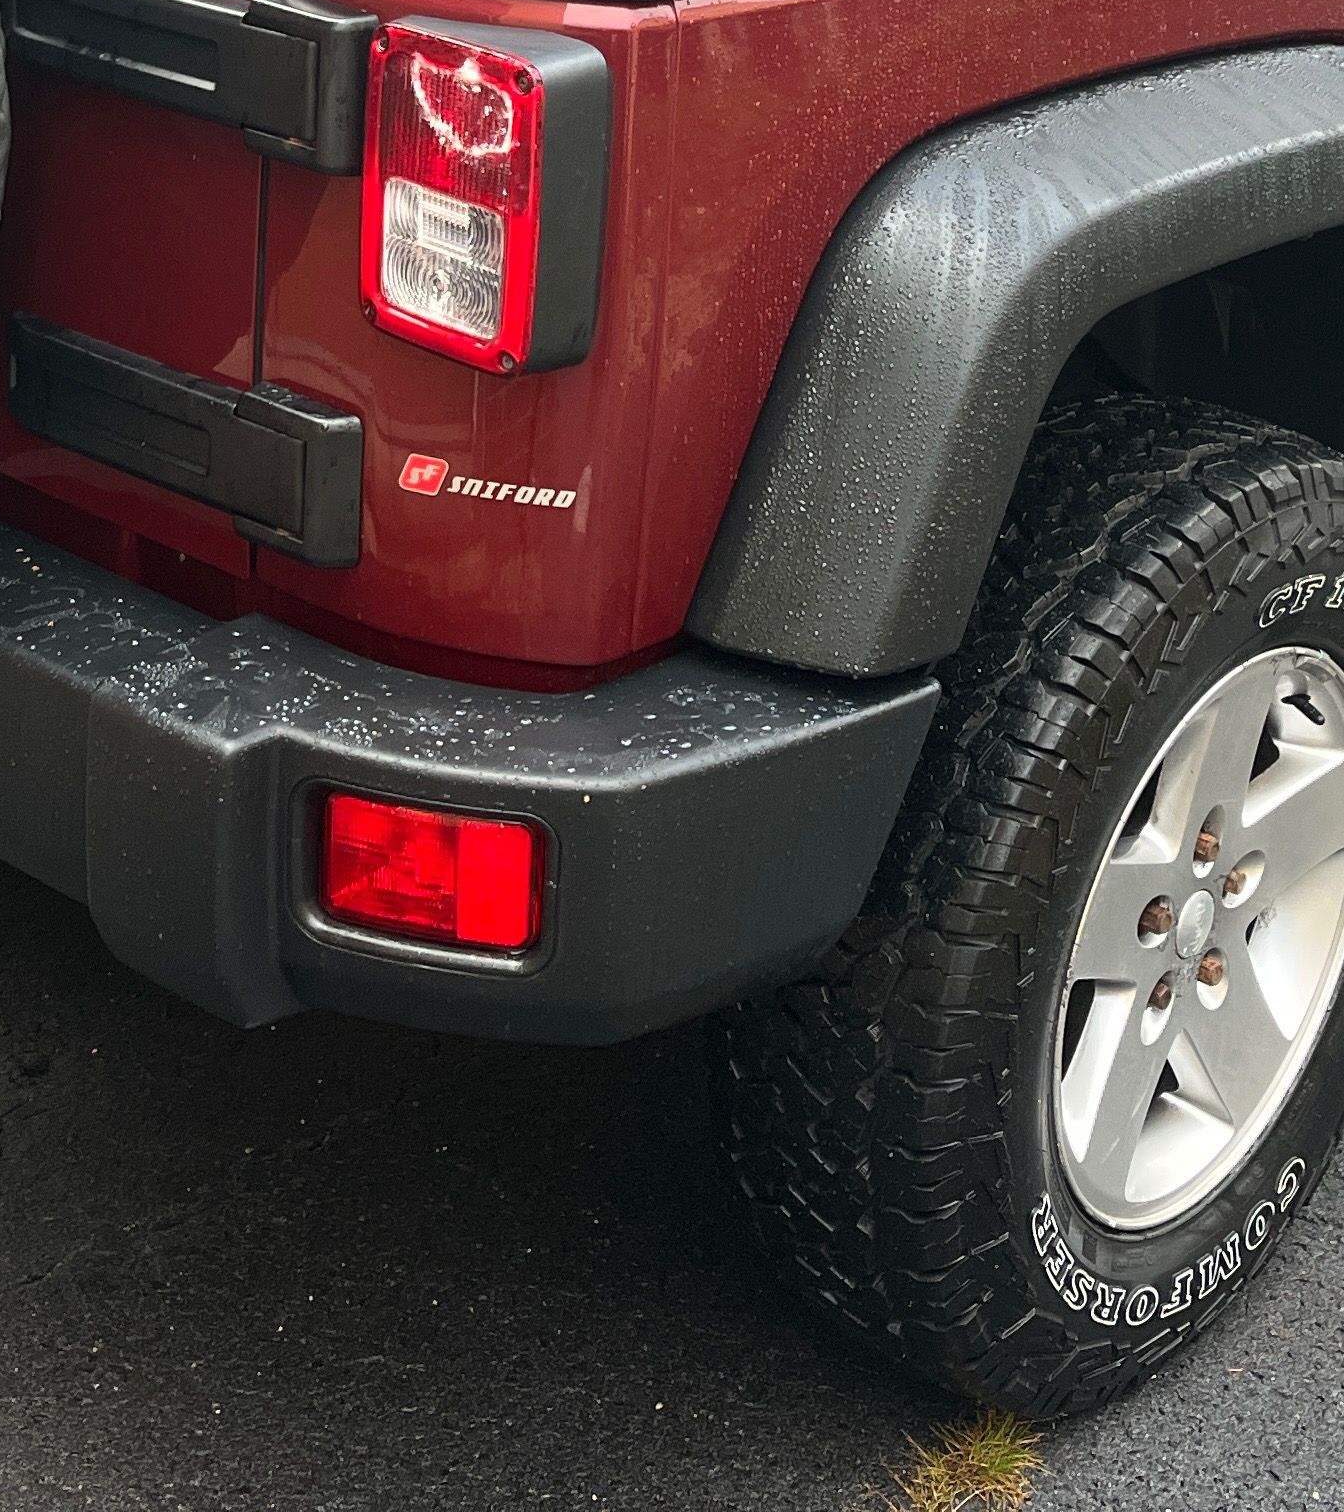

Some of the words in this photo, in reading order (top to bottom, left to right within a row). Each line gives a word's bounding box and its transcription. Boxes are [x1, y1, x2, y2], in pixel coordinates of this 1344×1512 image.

[447, 476, 577, 508] SNIFORD
[1259, 573, 1326, 628] CF
[1031, 1156, 1306, 1326] COMFORSER
